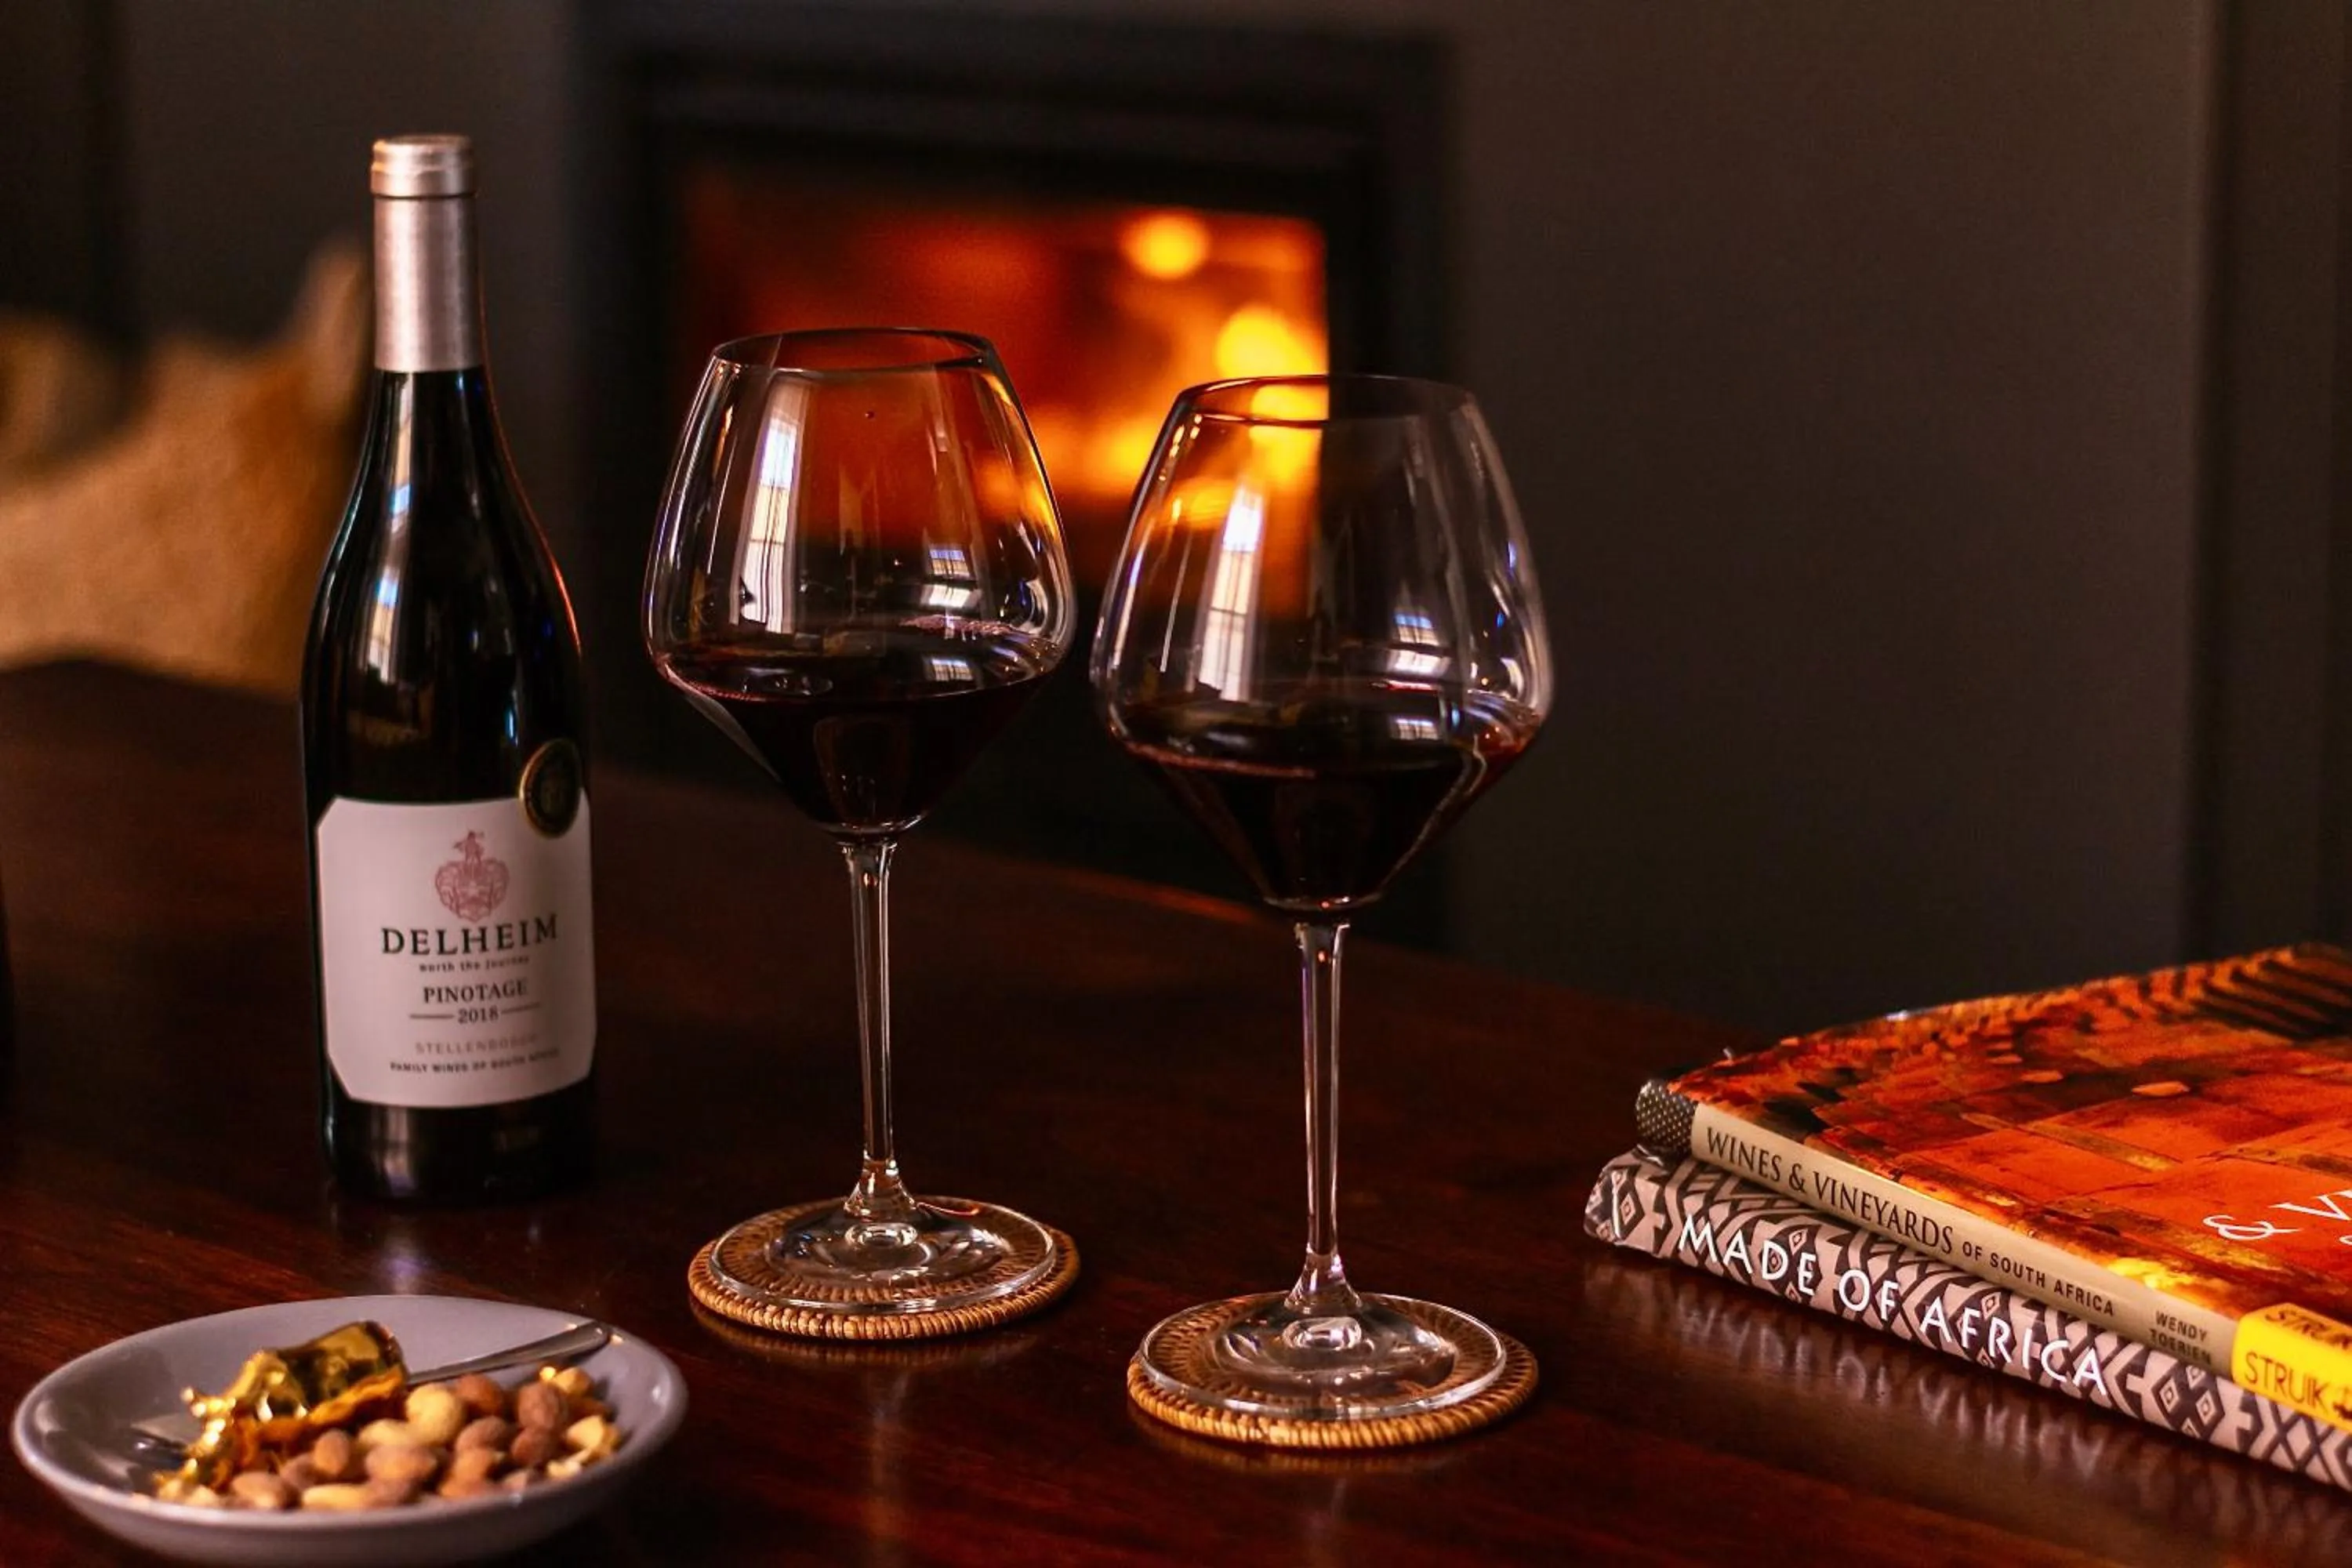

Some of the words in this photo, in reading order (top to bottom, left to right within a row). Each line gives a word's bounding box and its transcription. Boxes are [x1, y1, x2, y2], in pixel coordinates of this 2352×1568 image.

[381, 913, 559, 955] DELHEIM
[460, 960, 481, 971] the
[423, 980, 528, 1004] PINOTAGE
[457, 1005, 499, 1024] 2018
[1707, 1127, 1782, 1182] WINES
[1788, 1163, 1807, 1193] &
[1812, 1171, 1953, 1255] VINEYARDS
[1962, 1240, 1983, 1261] OF
[1990, 1252, 2046, 1289] SOUTH
[2053, 1279, 2114, 1317] AFRICA
[2202, 1214, 2303, 1241] &
[2267, 1189, 2352, 1221] V
[1679, 1214, 1817, 1296] MADE
[1839, 1269, 1899, 1321] OF
[1919, 1295, 2107, 1396] AFRICA
[2156, 1310, 2208, 1342] WENDY
[2244, 1350, 2331, 1416] STRUIK
